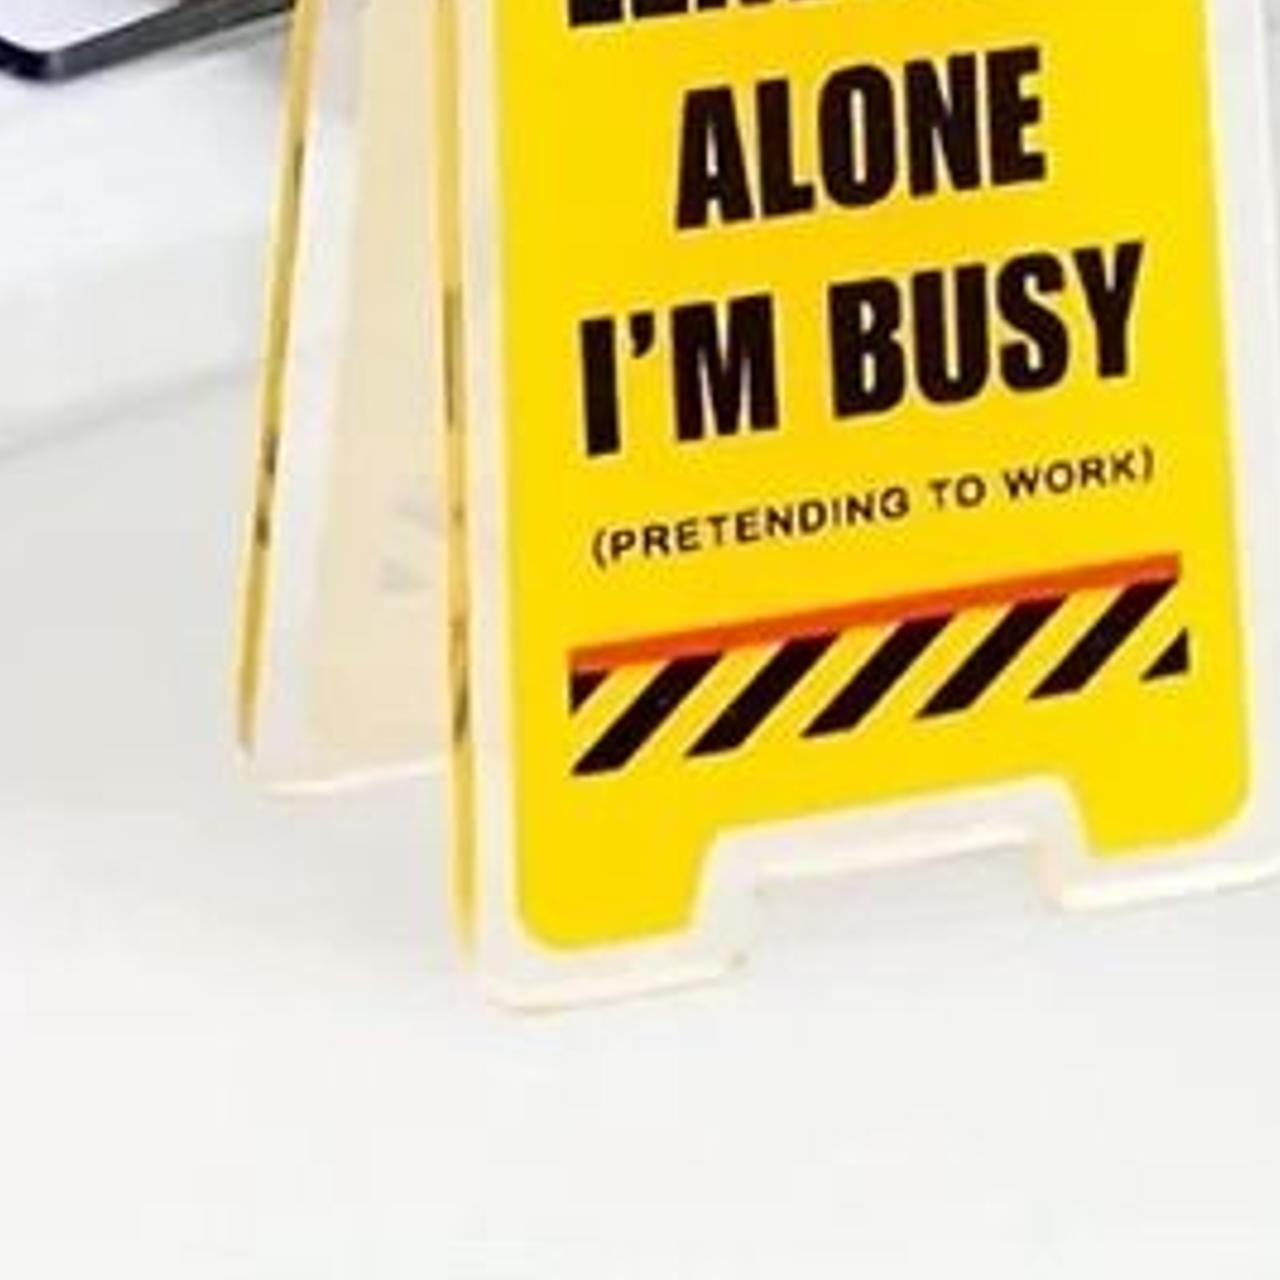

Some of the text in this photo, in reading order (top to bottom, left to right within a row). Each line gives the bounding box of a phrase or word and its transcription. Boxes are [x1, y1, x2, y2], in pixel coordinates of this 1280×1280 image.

[675, 44, 1047, 230] ALONE
[579, 241, 1144, 457] I'M BUSY
[591, 447, 1154, 568] (PRETENDING TO WORK)
